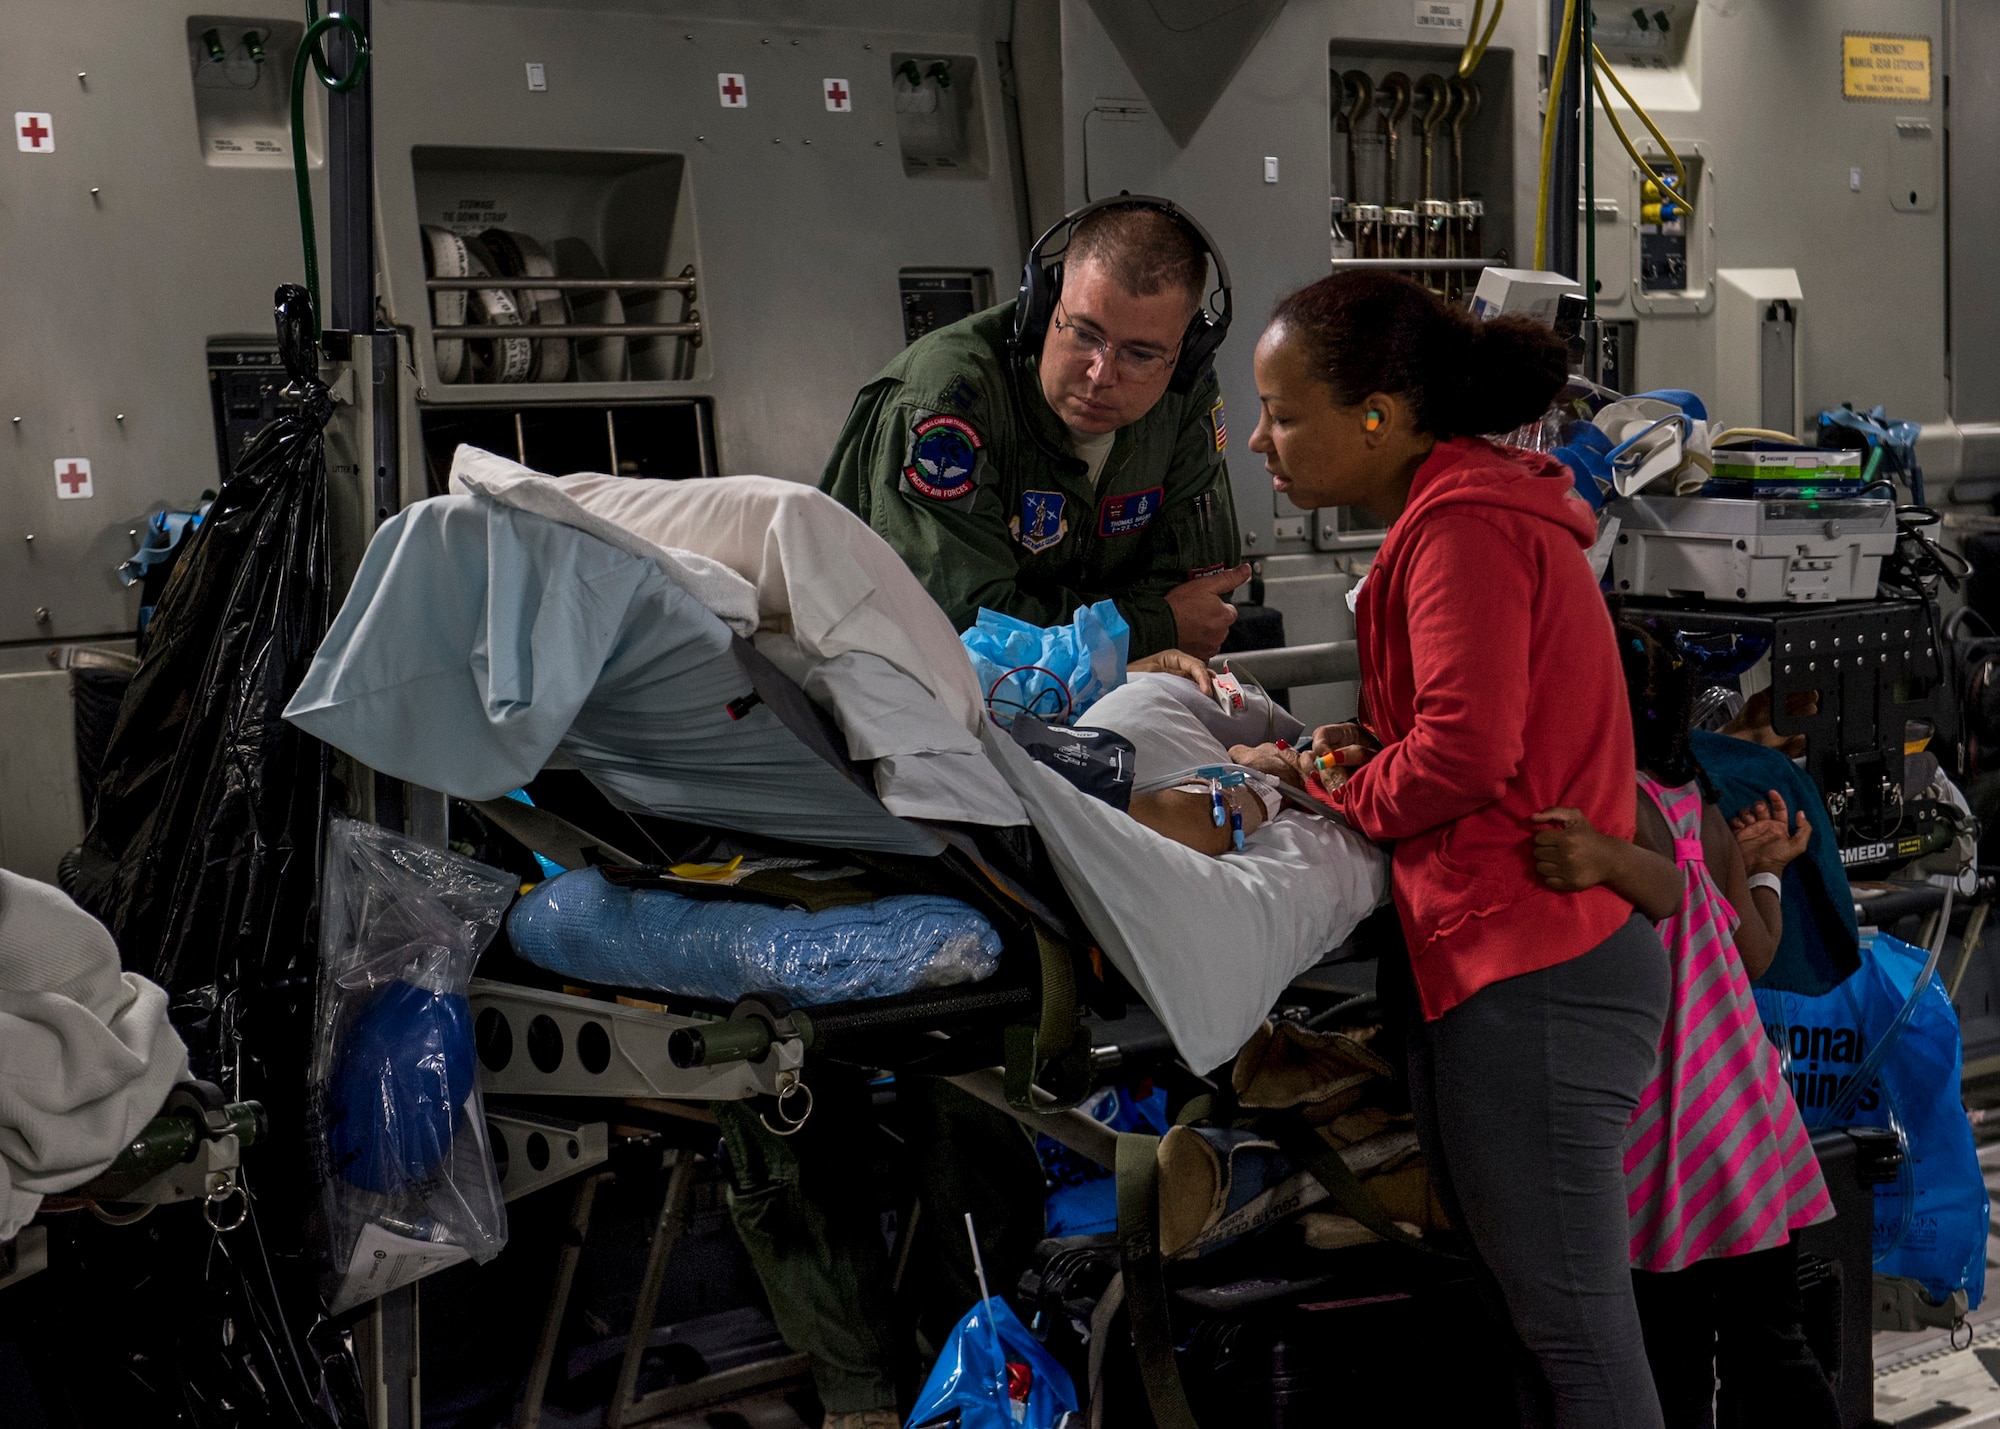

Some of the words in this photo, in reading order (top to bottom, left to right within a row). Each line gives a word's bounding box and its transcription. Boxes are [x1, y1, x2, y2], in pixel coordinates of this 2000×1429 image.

[1416, 15, 1429, 25] LOW
[1430, 16, 1445, 26] FLOW
[1447, 17, 1463, 27] VALVE
[1870, 42, 1904, 55] EMERGENCY
[1849, 56, 1873, 68] MANUAL
[1875, 58, 1891, 70] GEAR
[1893, 59, 1925, 72] EXTENSION
[456, 211, 480, 222] DOWN
[482, 212, 509, 223] STRAP
[934, 417, 946, 425] CARE
[953, 418, 974, 436] TRANSPORT
[909, 472, 931, 493] PACIFIC
[930, 488, 942, 497] AIR
[943, 483, 969, 497] FORCES
[1110, 517, 1134, 528] THOMAS
[1218, 1210, 1245, 1231] 5000
